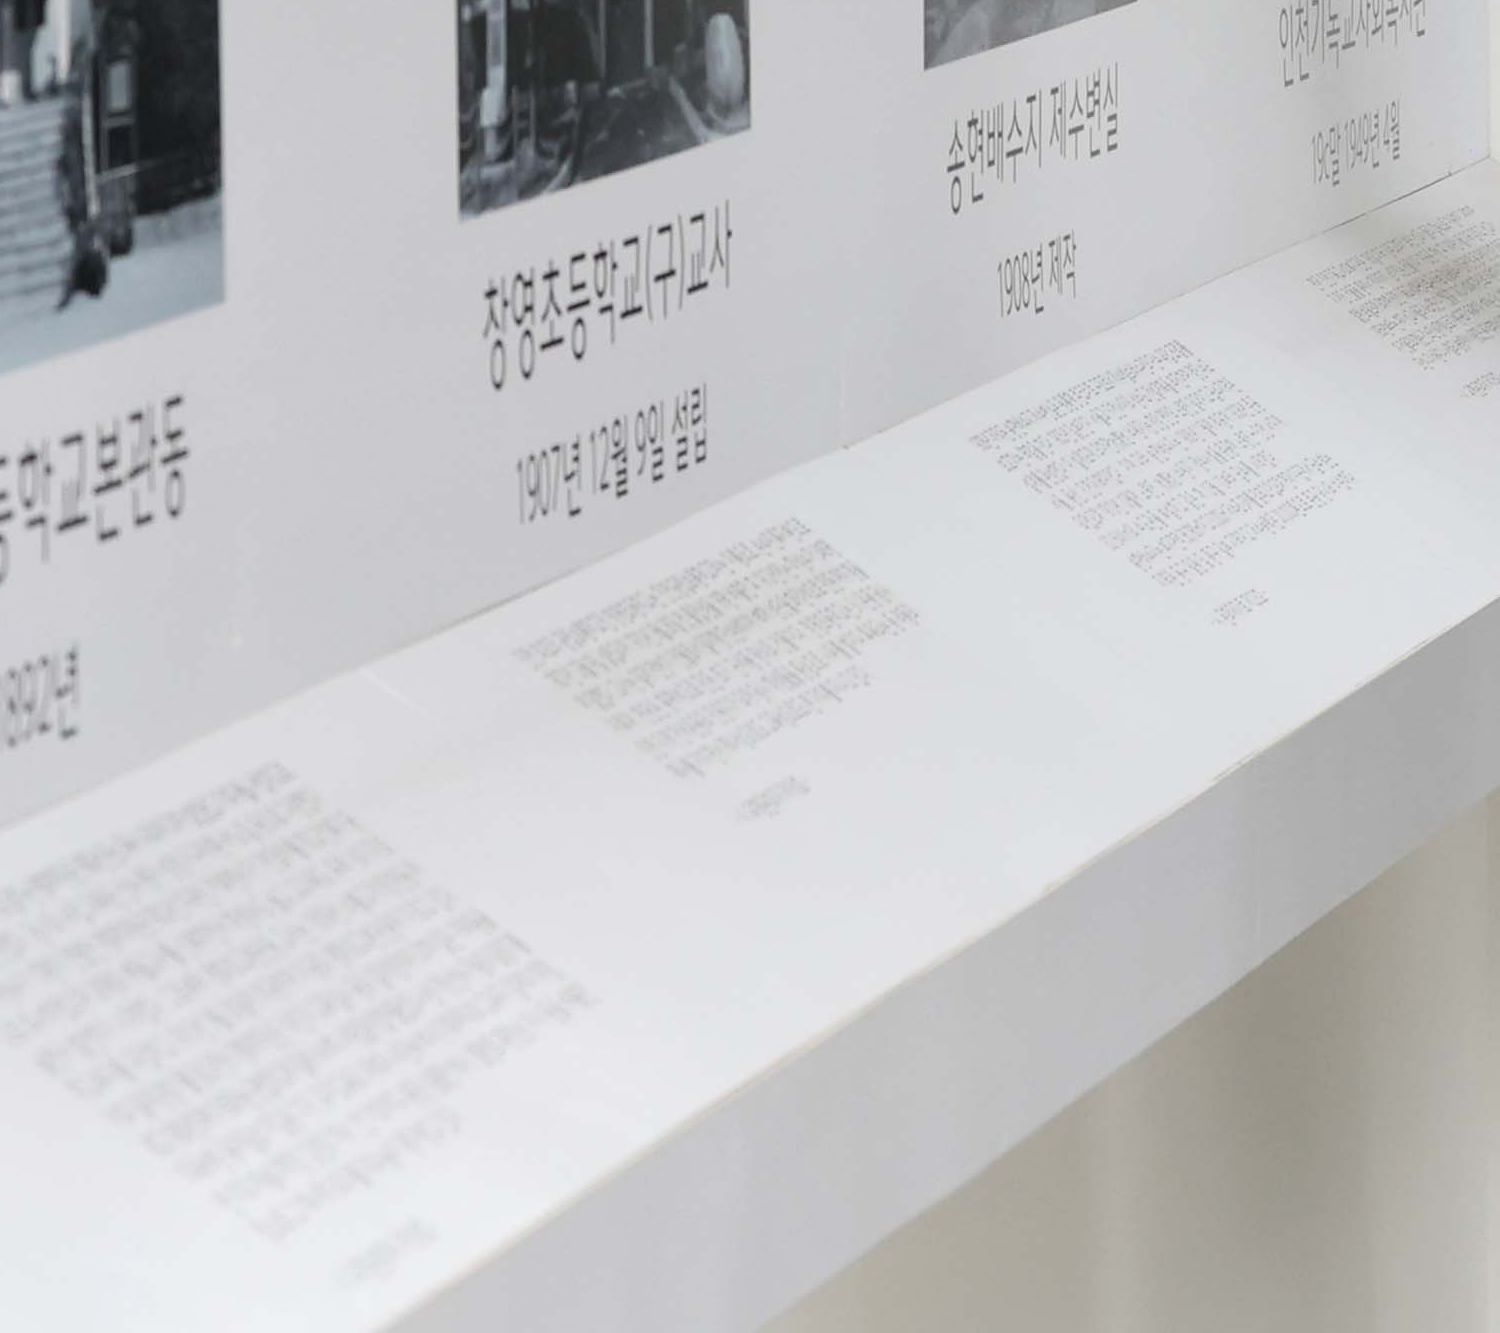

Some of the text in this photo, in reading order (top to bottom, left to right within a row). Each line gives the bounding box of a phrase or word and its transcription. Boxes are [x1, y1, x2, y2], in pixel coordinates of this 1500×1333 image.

[946, 63, 1118, 215] 송현배수지 제수변실
[1342, 109, 1380, 172] 1949년
[1383, 101, 1400, 161] 4월
[482, 200, 733, 392] 창영초등학교(구)교사
[997, 230, 1077, 317] 1908년 제작
[516, 383, 707, 524] 1907년 12월 9일 설립
